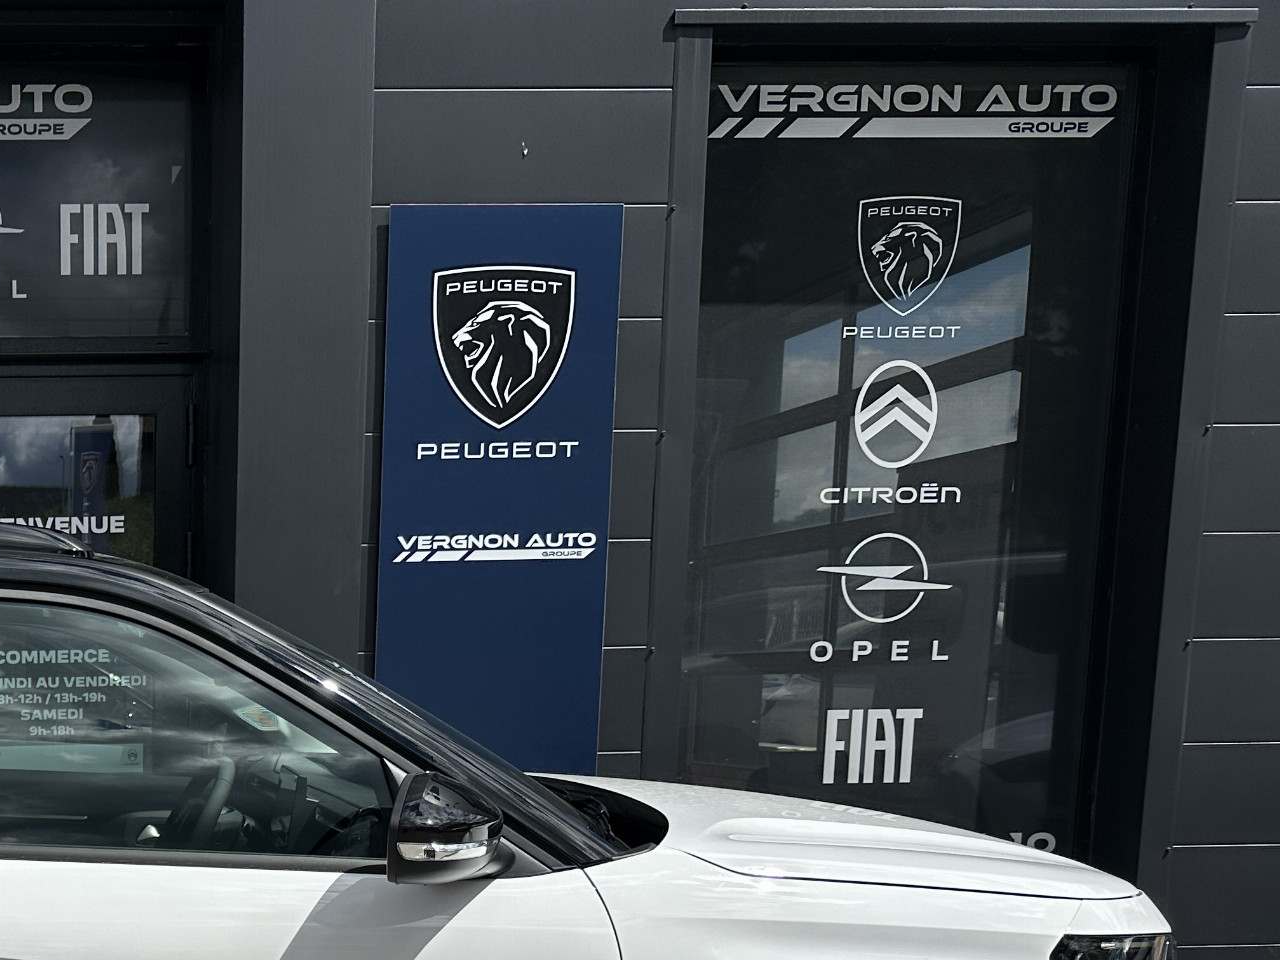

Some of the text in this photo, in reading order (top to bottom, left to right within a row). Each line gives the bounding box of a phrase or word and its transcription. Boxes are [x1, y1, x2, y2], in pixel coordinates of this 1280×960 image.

[718, 85, 1117, 112] VERGNON AUTO
[1009, 122, 1089, 132] GROUPE
[868, 206, 952, 217] PEUGEOT
[60, 204, 149, 275] FIAT
[446, 280, 562, 295] PEUGEOT
[843, 326, 960, 338] PEUGEOT
[418, 442, 579, 459] PEUGEOT
[397, 533, 596, 550] VERGNON AUTO
[541, 550, 584, 558] GROUPE
[810, 640, 948, 662] OPEL
[36, 676, 59, 688] AU
[64, 674, 146, 688] VENDREDI
[45, 694, 50, 705] /
[54, 692, 106, 703] 13h-19h
[20, 708, 84, 721] SAMEDI
[29, 725, 75, 737] 9h-18h
[823, 709, 923, 784] FIAT
